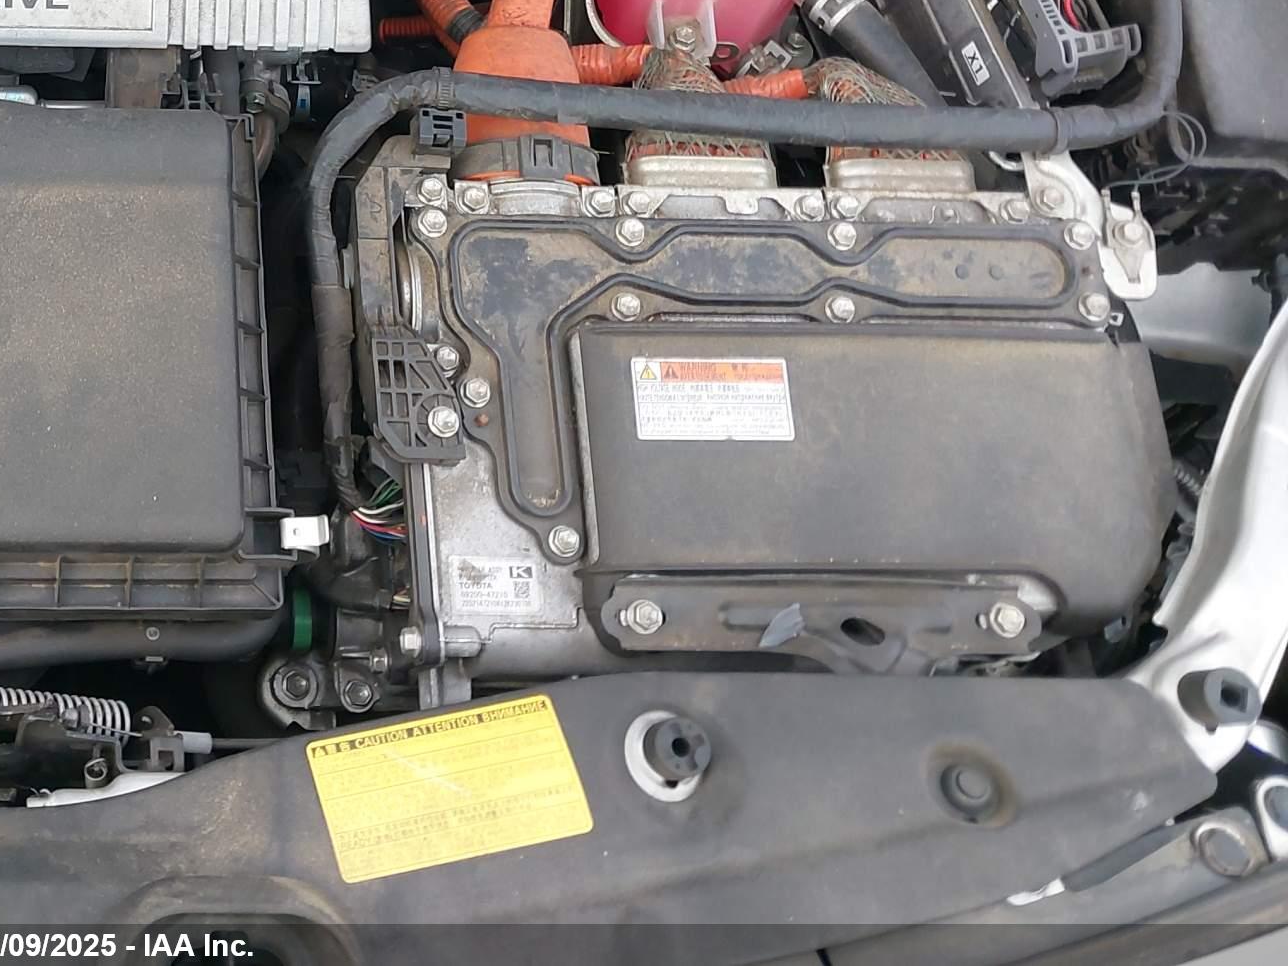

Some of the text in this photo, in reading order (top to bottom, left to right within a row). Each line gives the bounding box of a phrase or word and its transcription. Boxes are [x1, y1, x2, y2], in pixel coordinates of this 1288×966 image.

[967, 51, 983, 74] X1
[355, 730, 409, 749] CAUTION
[412, 714, 479, 737] ATTENTION
[482, 700, 546, 722] ВНИМАНИЕ
